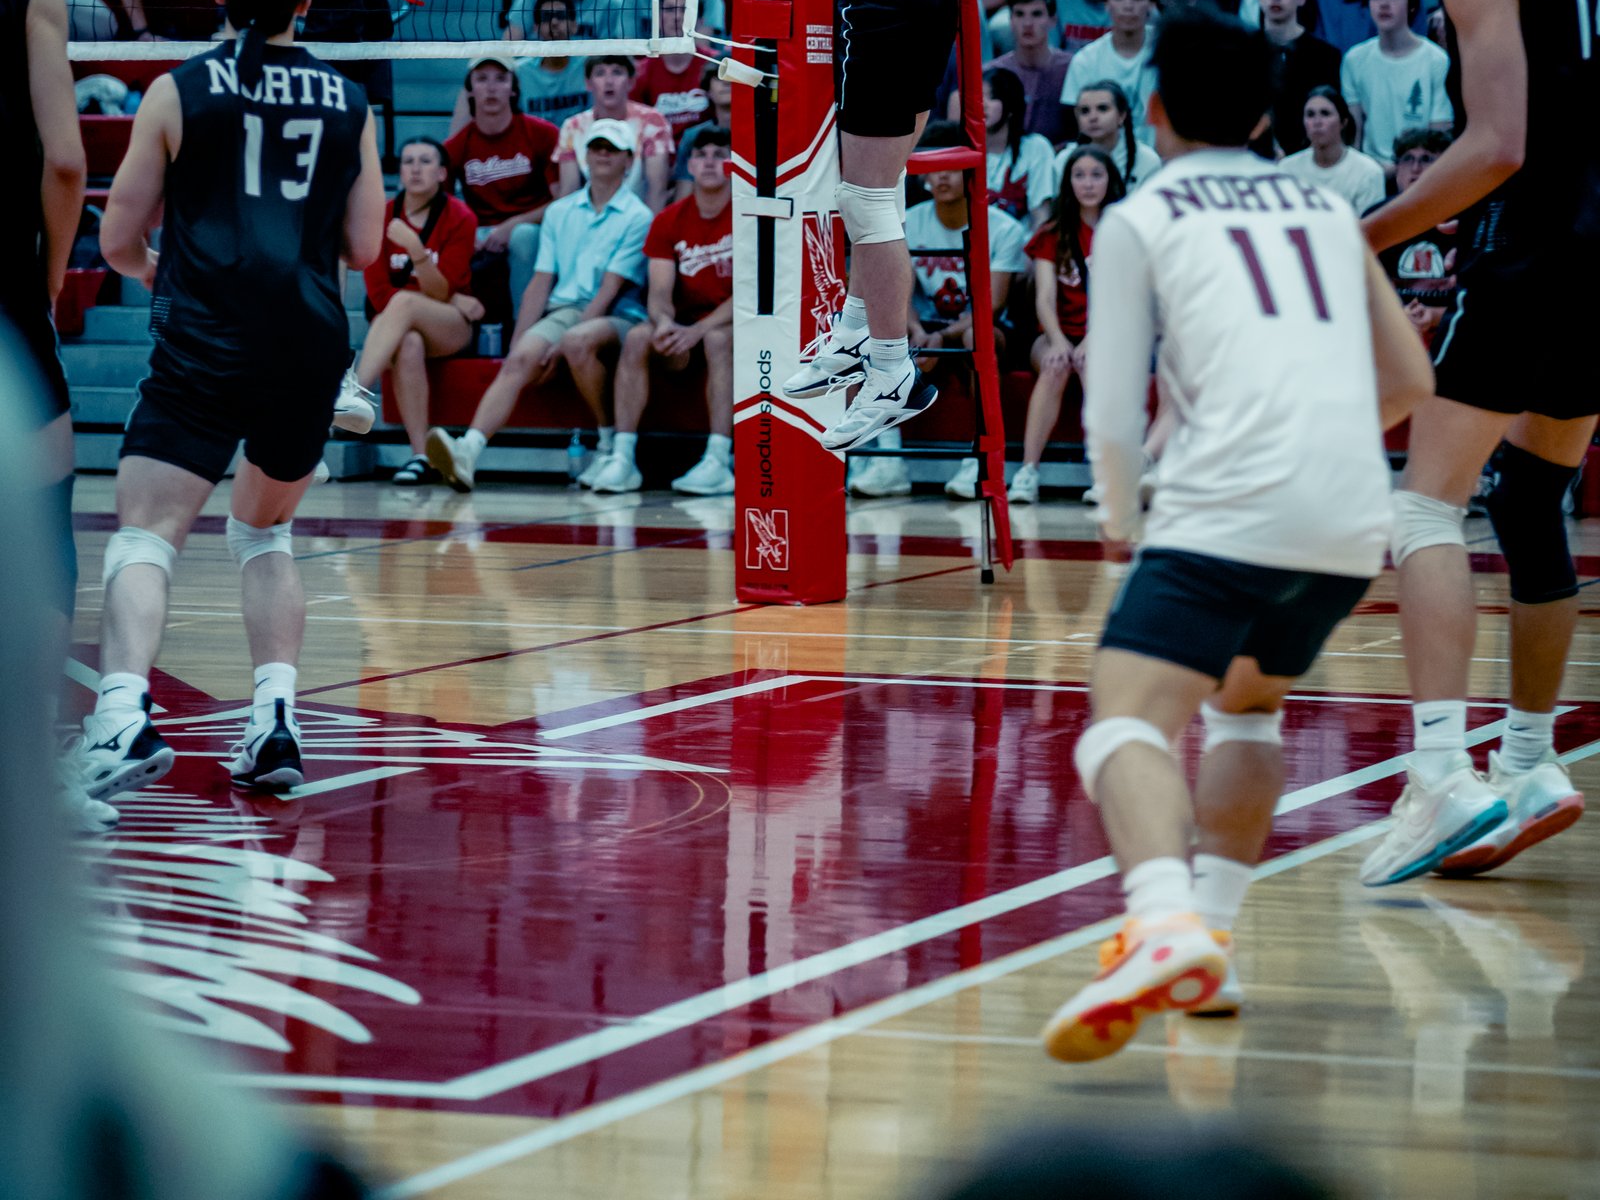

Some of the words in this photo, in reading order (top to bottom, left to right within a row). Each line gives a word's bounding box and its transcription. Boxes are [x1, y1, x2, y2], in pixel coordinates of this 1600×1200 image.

[243, 112, 324, 201] 13
[1157, 173, 1334, 221] NORTH
[1226, 227, 1332, 322] 11
[757, 349, 773, 414] sports
[757, 418, 774, 497] imports
